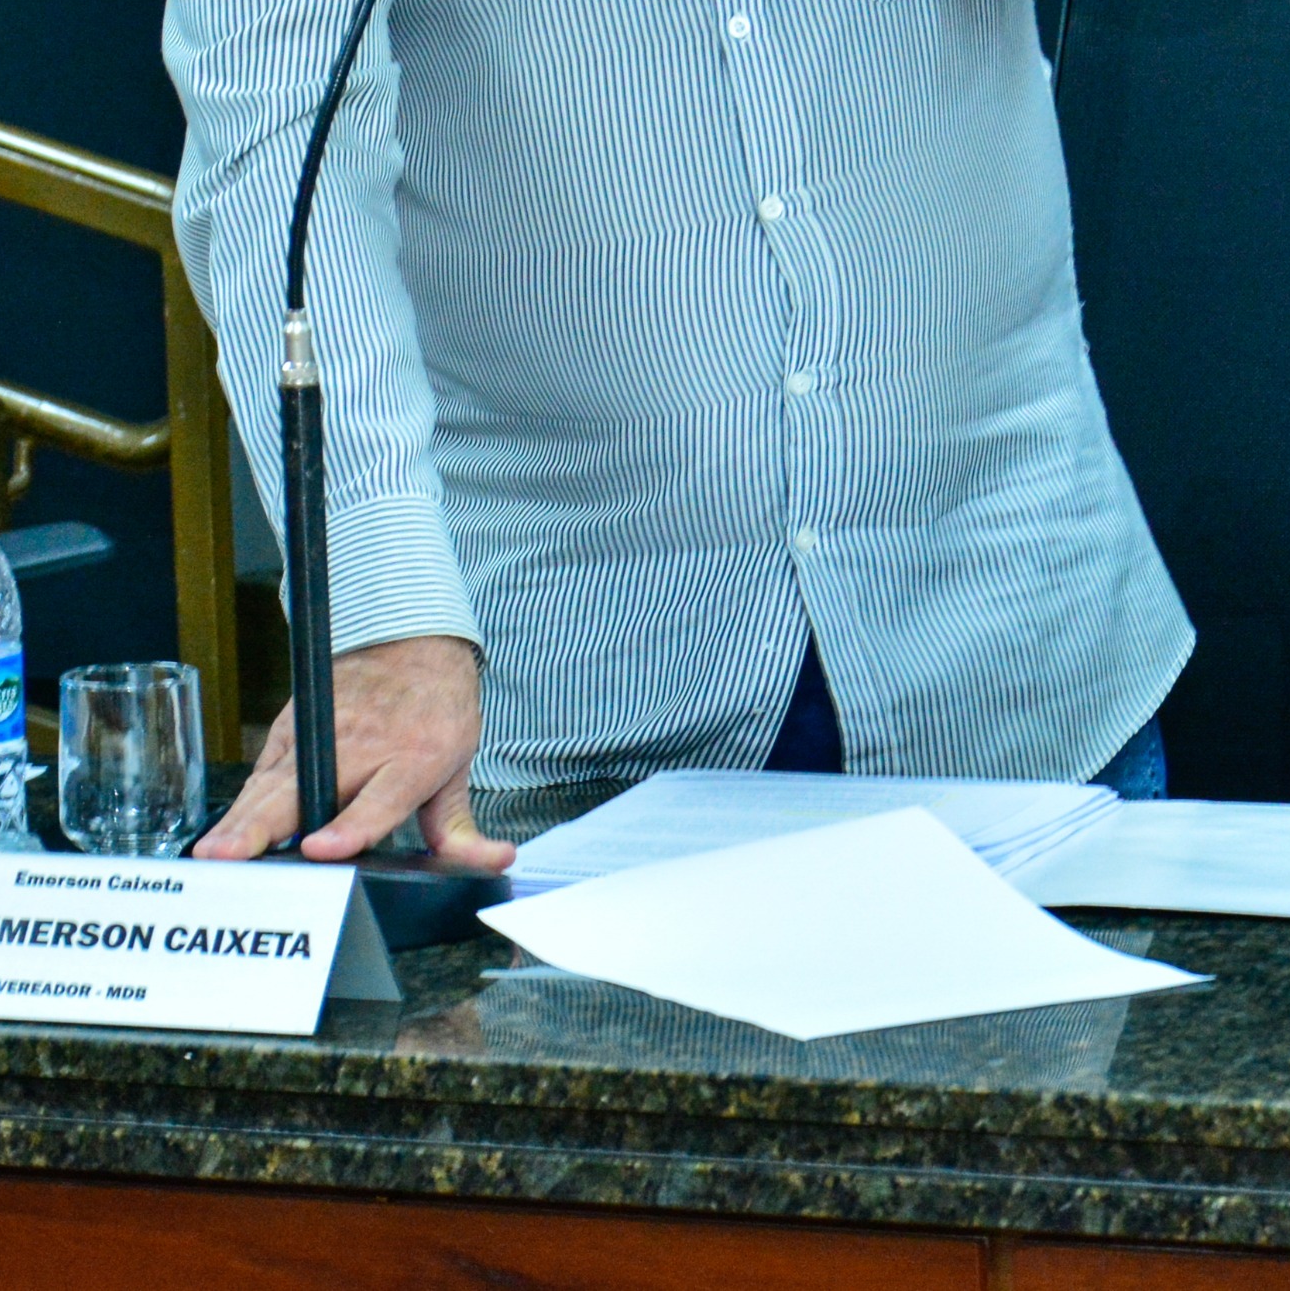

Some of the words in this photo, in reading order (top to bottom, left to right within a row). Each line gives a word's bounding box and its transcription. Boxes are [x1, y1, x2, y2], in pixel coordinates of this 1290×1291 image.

[14, 869, 102, 892] Emerson
[108, 874, 184, 895] Caixeta
[164, 926, 313, 959] CAIXETA
[106, 985, 147, 1001] MDB
